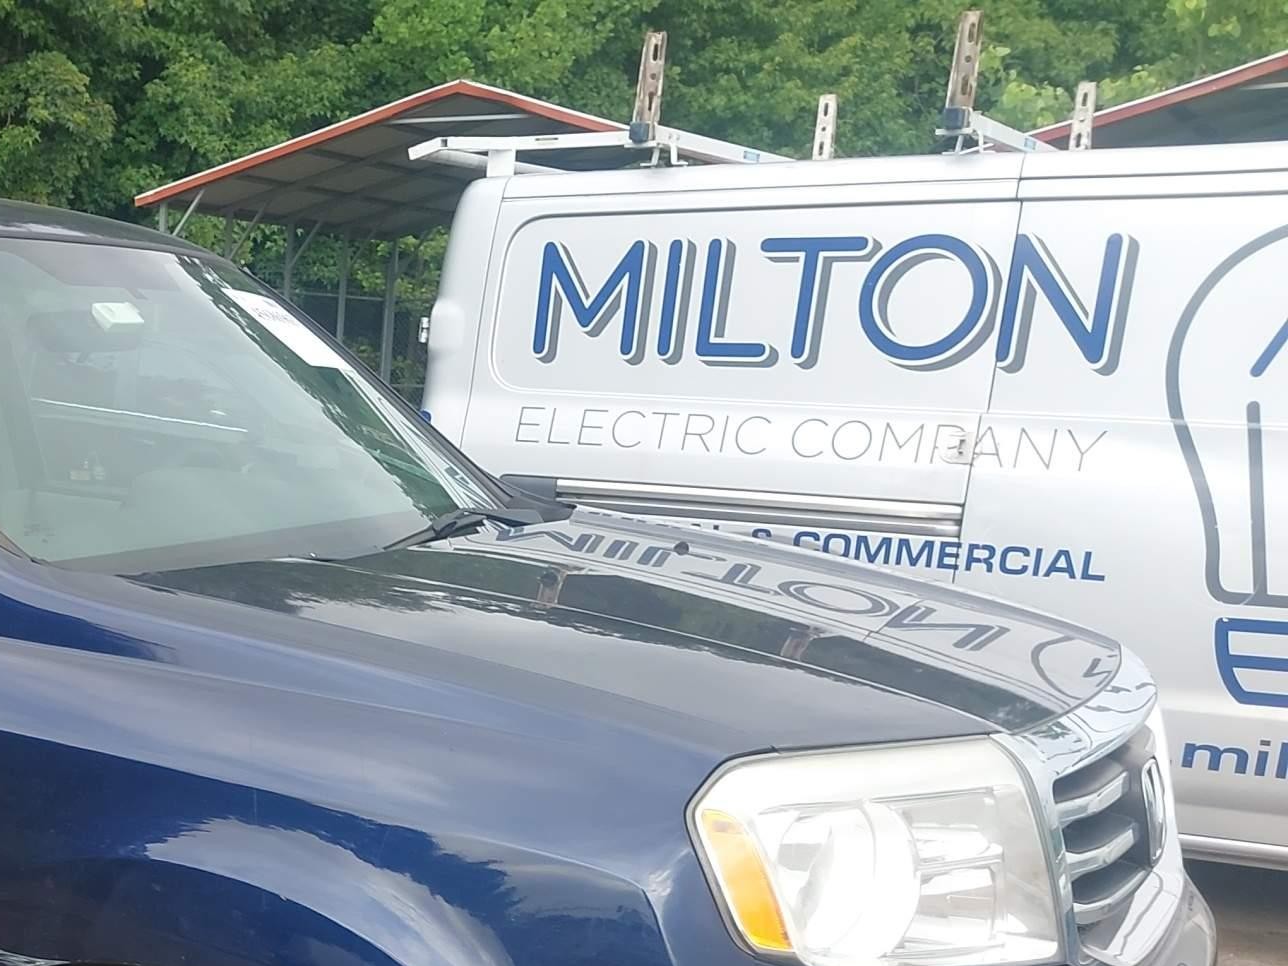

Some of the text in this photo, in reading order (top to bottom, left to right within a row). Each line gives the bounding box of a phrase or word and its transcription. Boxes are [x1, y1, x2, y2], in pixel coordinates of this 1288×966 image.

[532, 232, 1139, 376] MILTON
[514, 405, 1108, 472] ELECTRIC COMPANY
[793, 531, 1106, 582] COMMERCIAL
